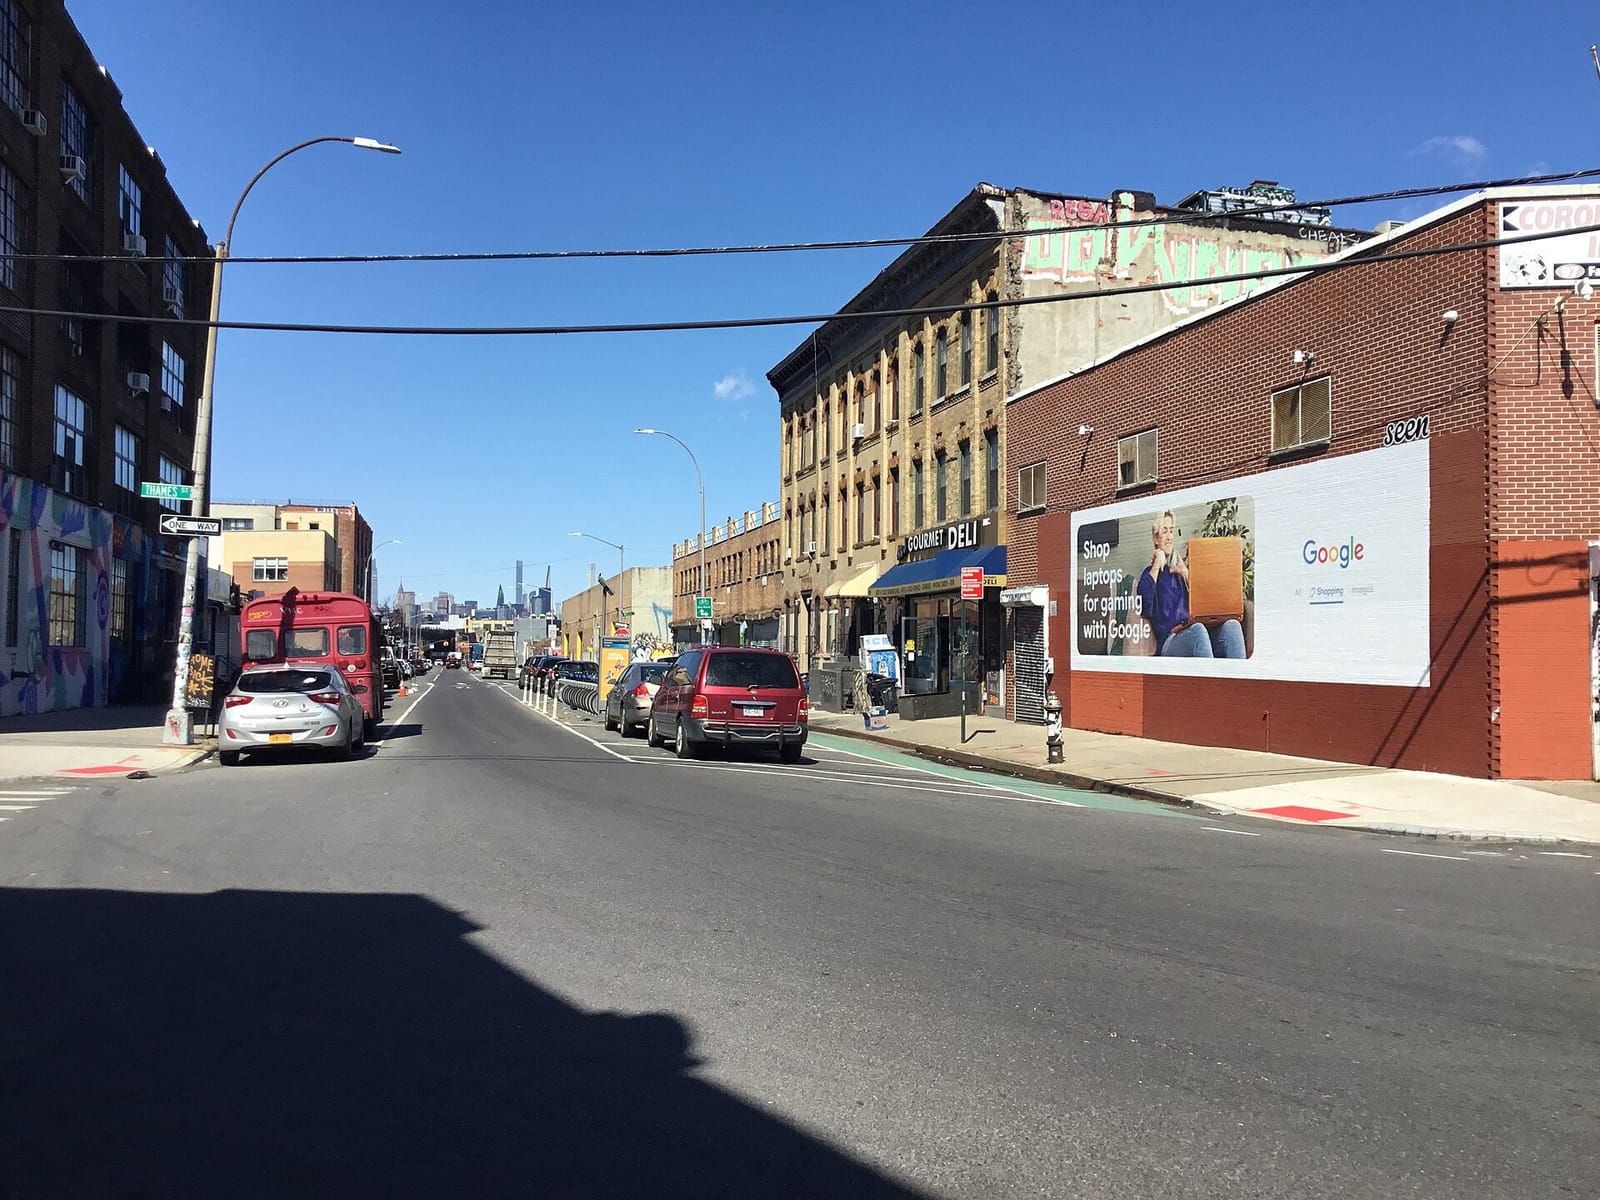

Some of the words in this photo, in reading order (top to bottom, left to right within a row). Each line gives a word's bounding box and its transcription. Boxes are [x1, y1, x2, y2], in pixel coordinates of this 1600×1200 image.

[1384, 414, 1430, 447] seen
[145, 484, 178, 497] THAMES
[169, 521, 188, 529] ONE
[197, 523, 217, 531] WAY
[908, 528, 944, 552] GOURMET
[948, 520, 977, 550] DELI
[1083, 540, 1111, 563] Shop
[1303, 535, 1364, 569] Google
[1083, 566, 1123, 591] laptops
[1083, 593, 1099, 612] for
[1100, 590, 1143, 616] gaming
[1317, 586, 1344, 597] Shopping
[1083, 619, 1108, 639] with
[1108, 619, 1151, 644] Google
